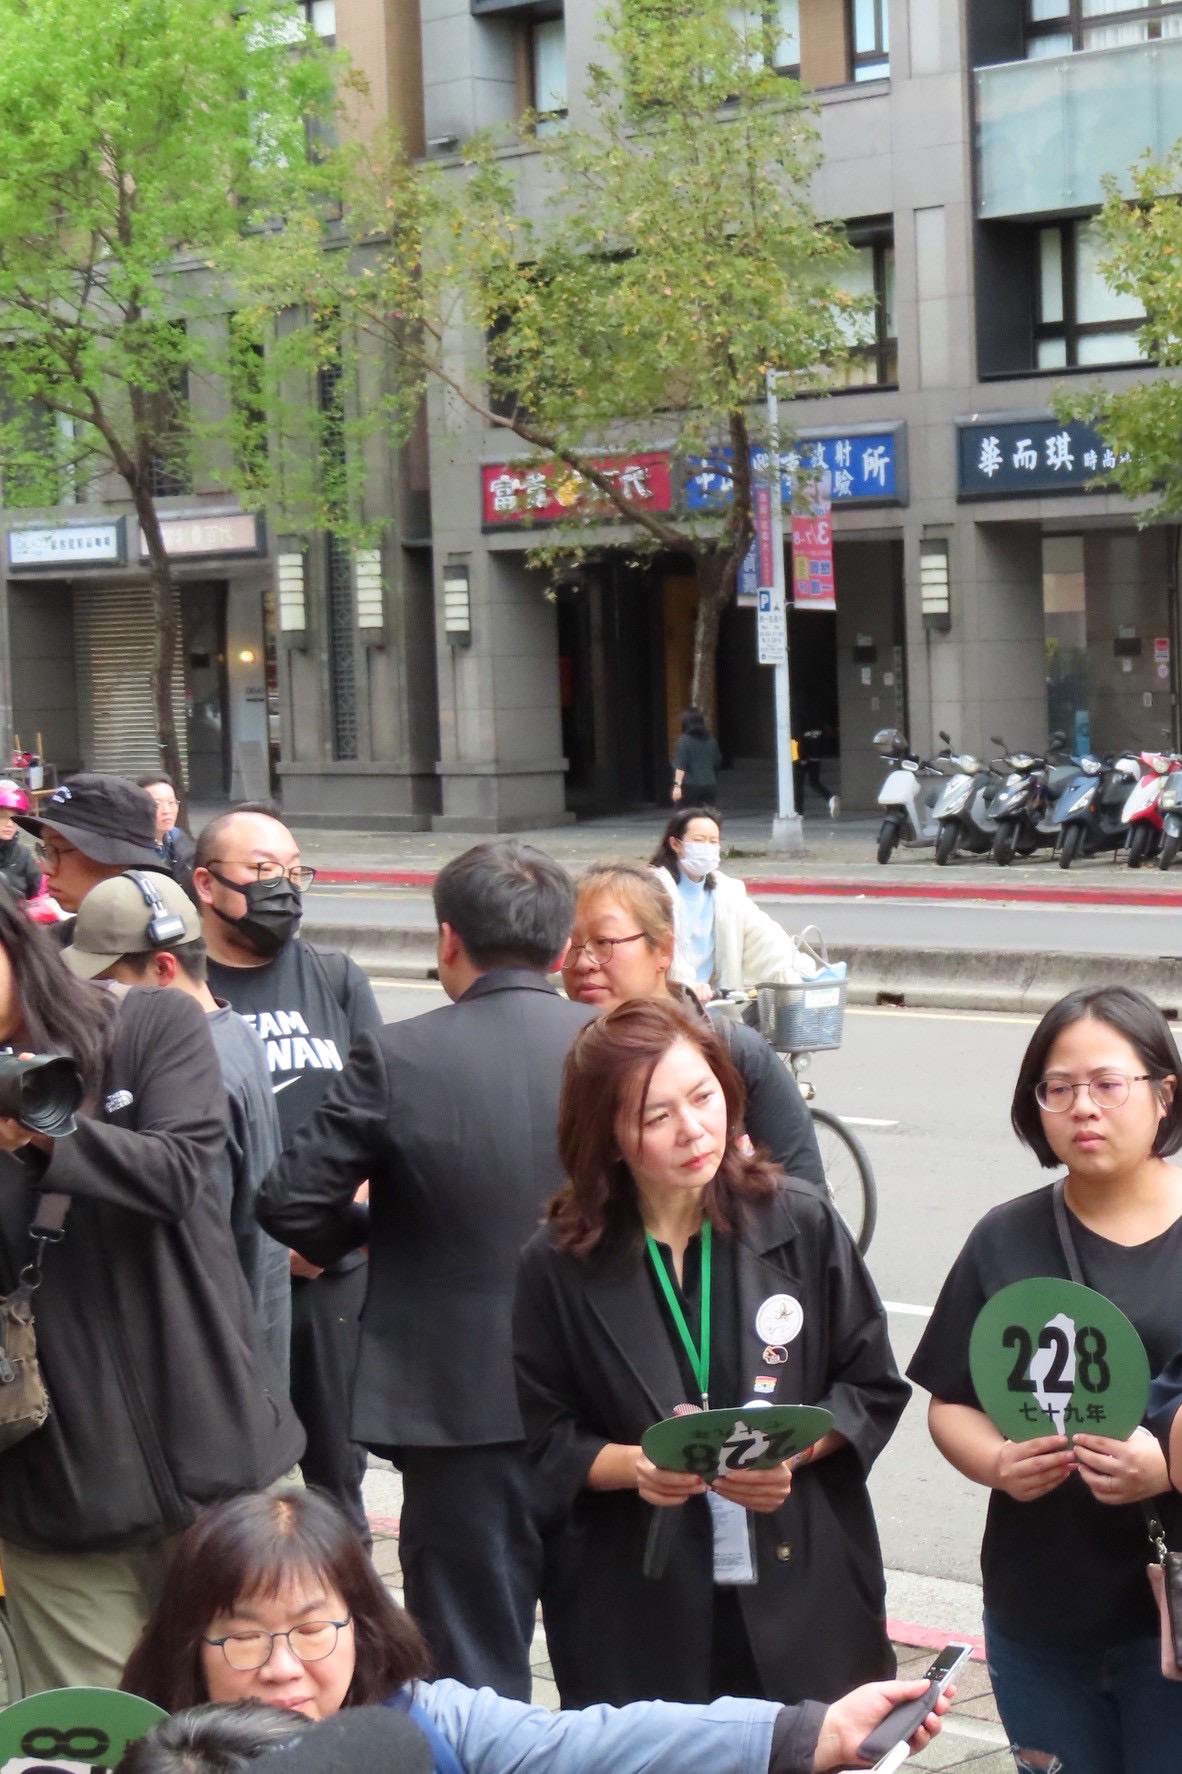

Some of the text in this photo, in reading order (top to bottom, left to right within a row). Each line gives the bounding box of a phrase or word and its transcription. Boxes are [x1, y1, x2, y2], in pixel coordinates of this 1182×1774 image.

[978, 431, 1075, 478] 華而琪
[1001, 1325, 1111, 1394] 228
[1019, 1402, 1106, 1423] 七十九年
[682, 1428, 796, 1474] 228
